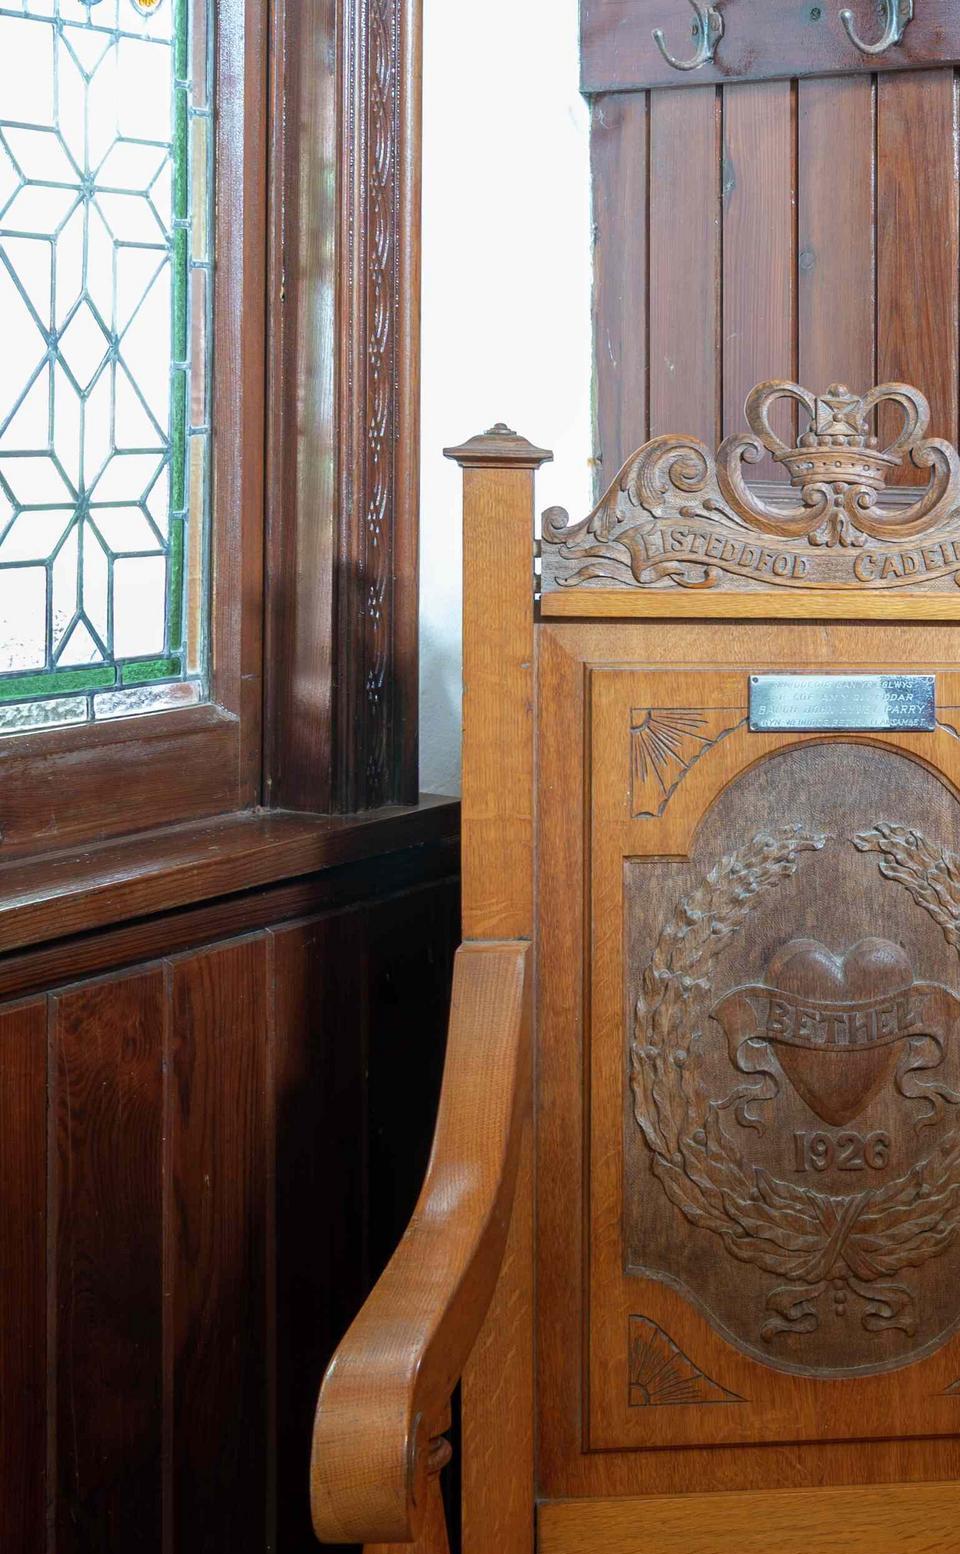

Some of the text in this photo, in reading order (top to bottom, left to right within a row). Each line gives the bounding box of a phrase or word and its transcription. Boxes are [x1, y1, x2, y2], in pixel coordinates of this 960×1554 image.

[646, 526, 808, 579] EISTEDDFOD
[767, 1000, 917, 1044] BETHEL
[793, 1131, 891, 1173] 1926
